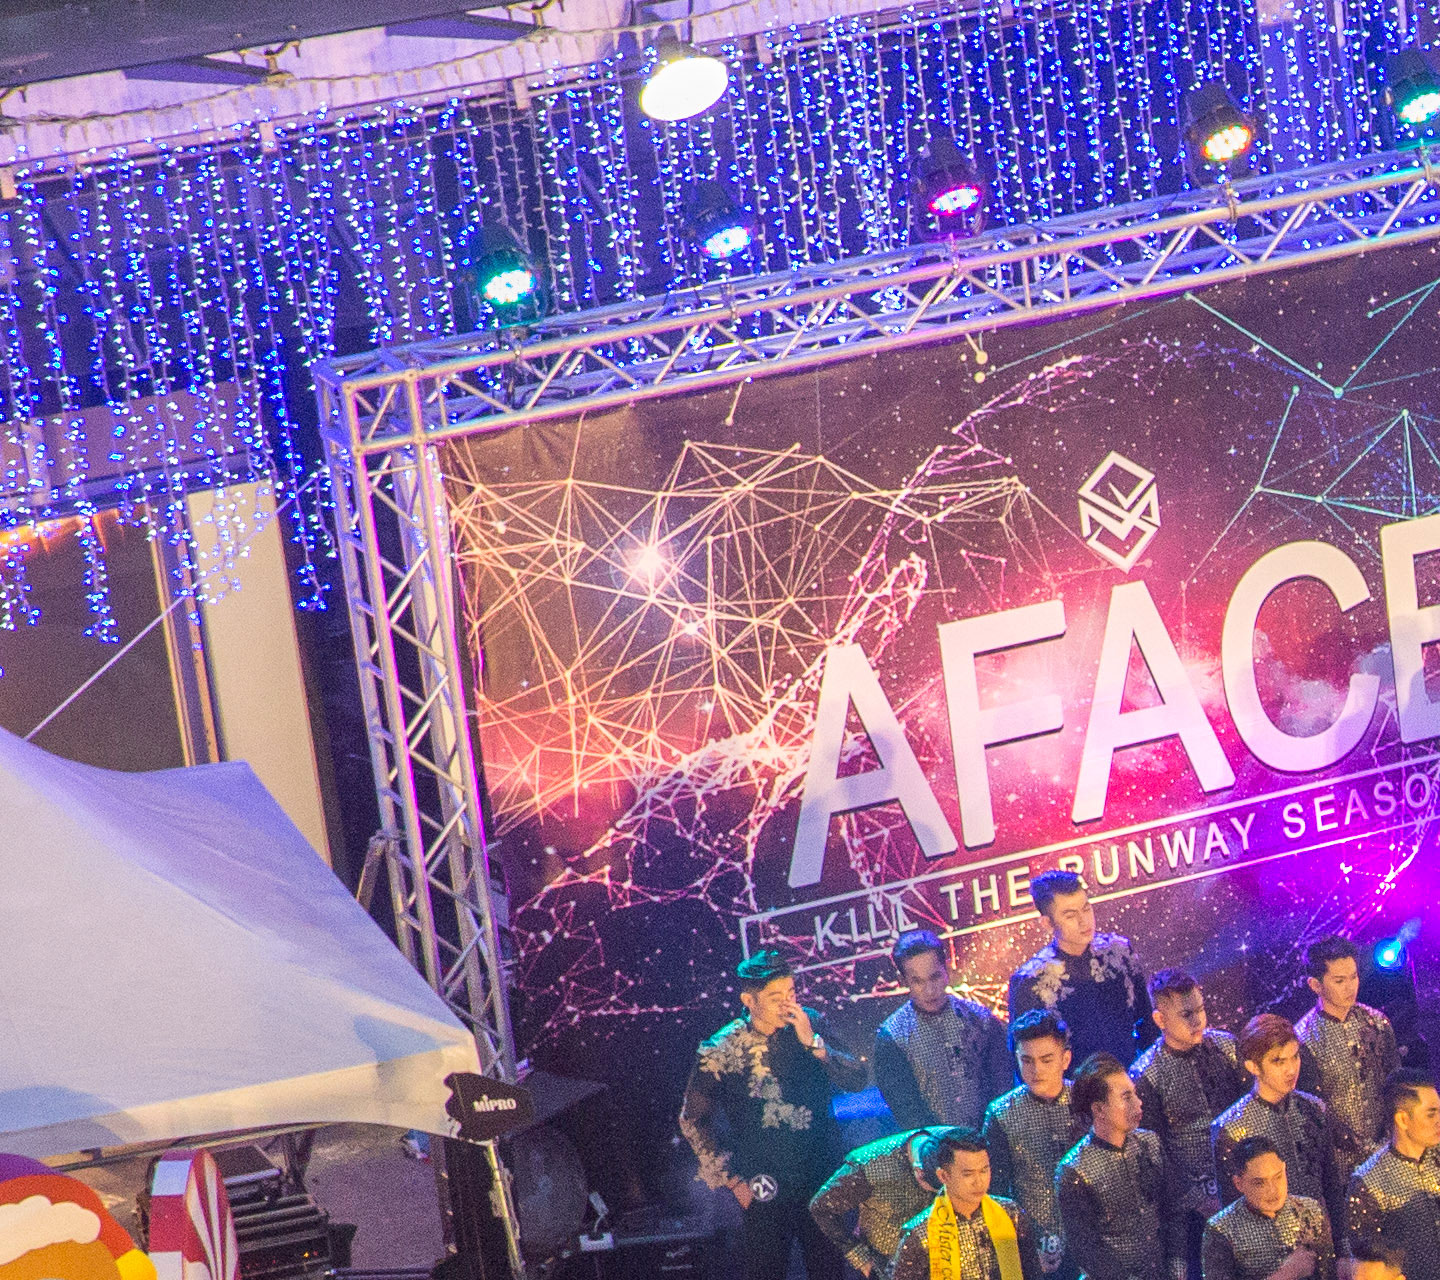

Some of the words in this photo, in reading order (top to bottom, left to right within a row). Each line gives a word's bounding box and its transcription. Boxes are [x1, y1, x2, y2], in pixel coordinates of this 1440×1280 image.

[940, 865, 1031, 920] THE
[1058, 824, 1251, 886] RUNWAY
[752, 1175, 775, 1199] 21
